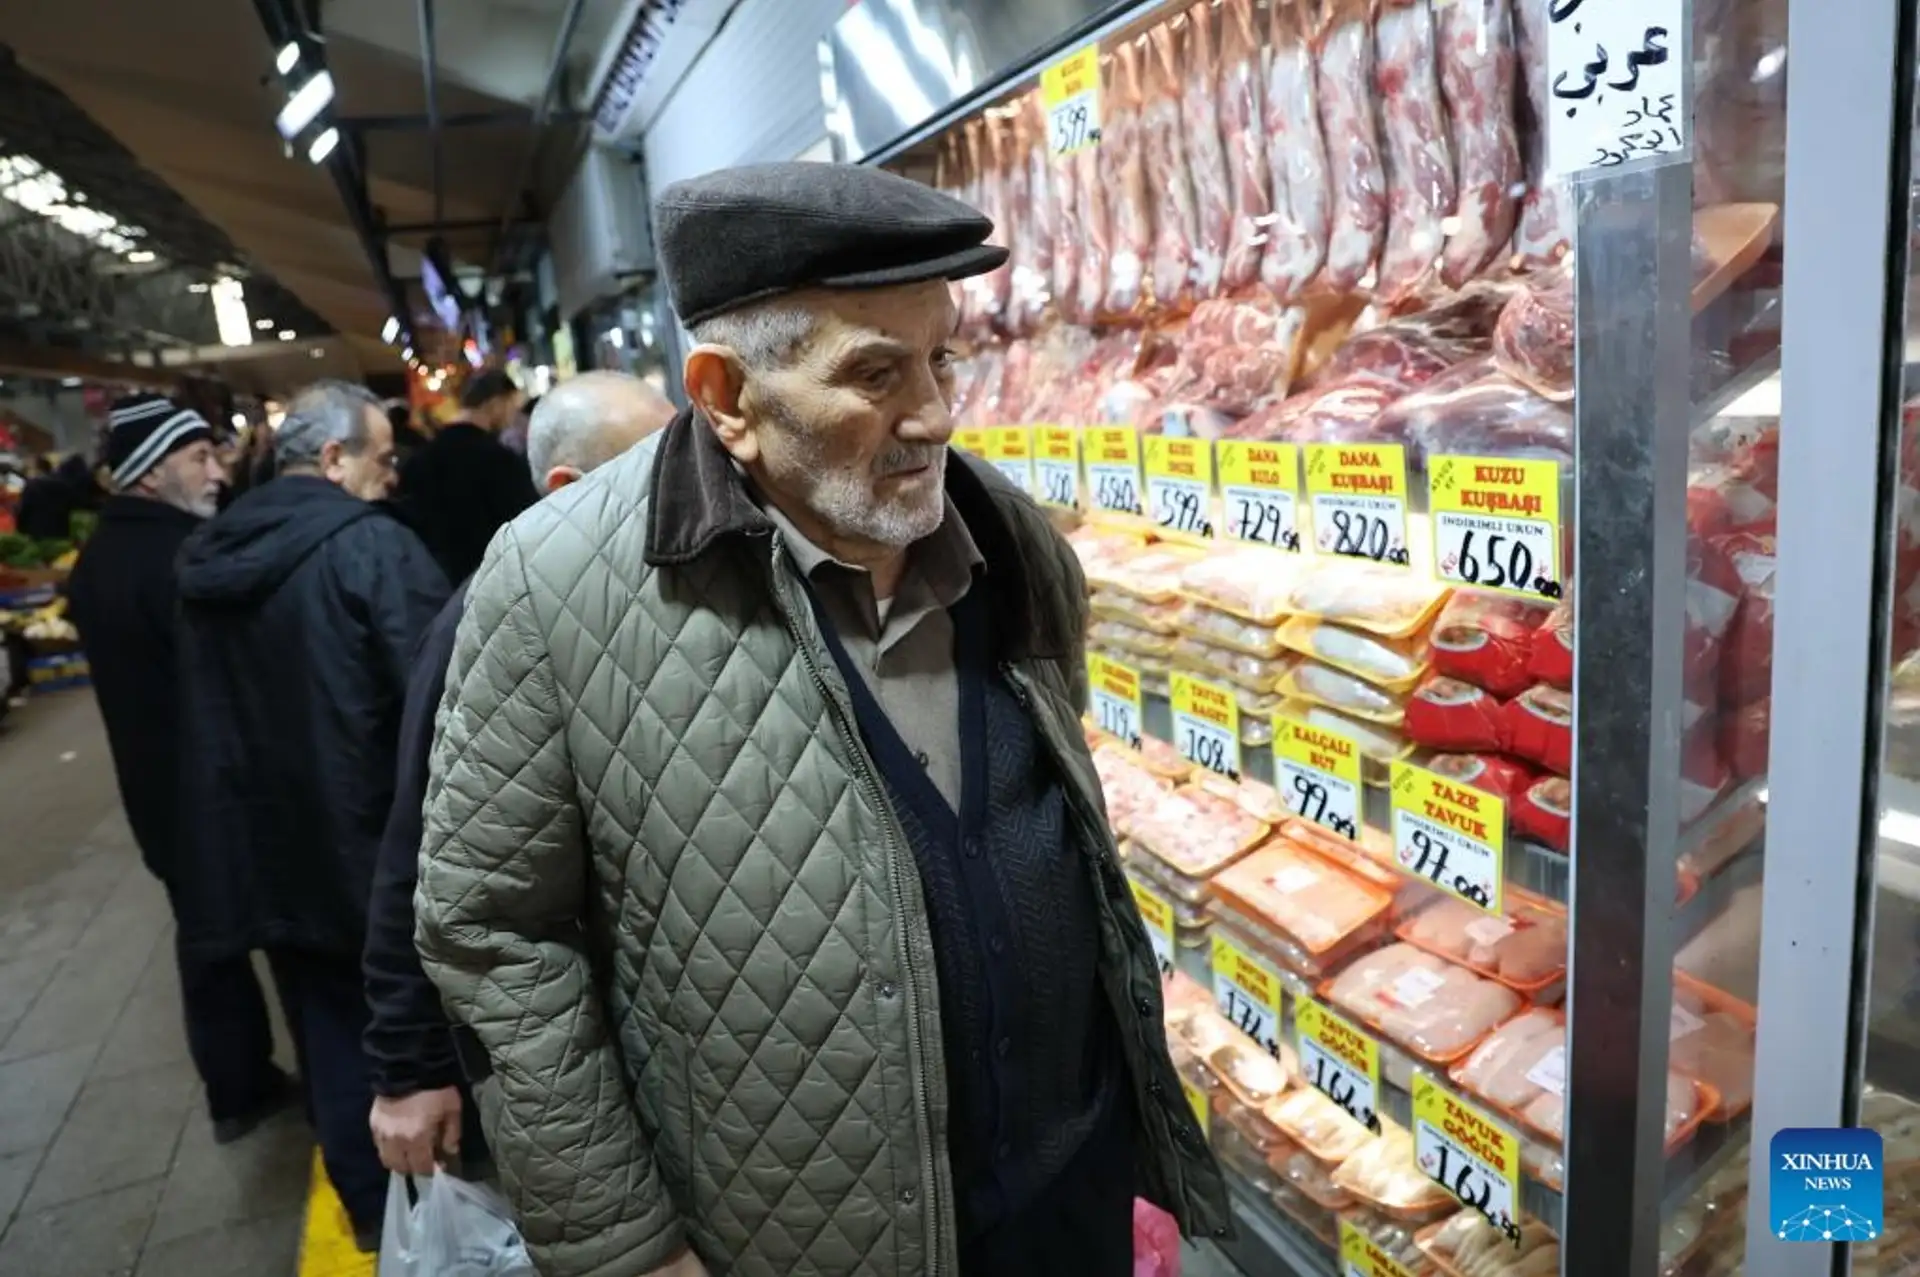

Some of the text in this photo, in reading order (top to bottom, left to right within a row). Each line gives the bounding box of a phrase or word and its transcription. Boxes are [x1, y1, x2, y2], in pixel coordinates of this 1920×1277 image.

[1339, 451, 1381, 468] DANA
[1475, 465, 1525, 485] KUZU
[1461, 489, 1542, 516] KUŞBAŞI
[1431, 780, 1480, 812] TAZE
[1423, 799, 1488, 840] TAVUK
[1443, 1098, 1505, 1151] TAVUK
